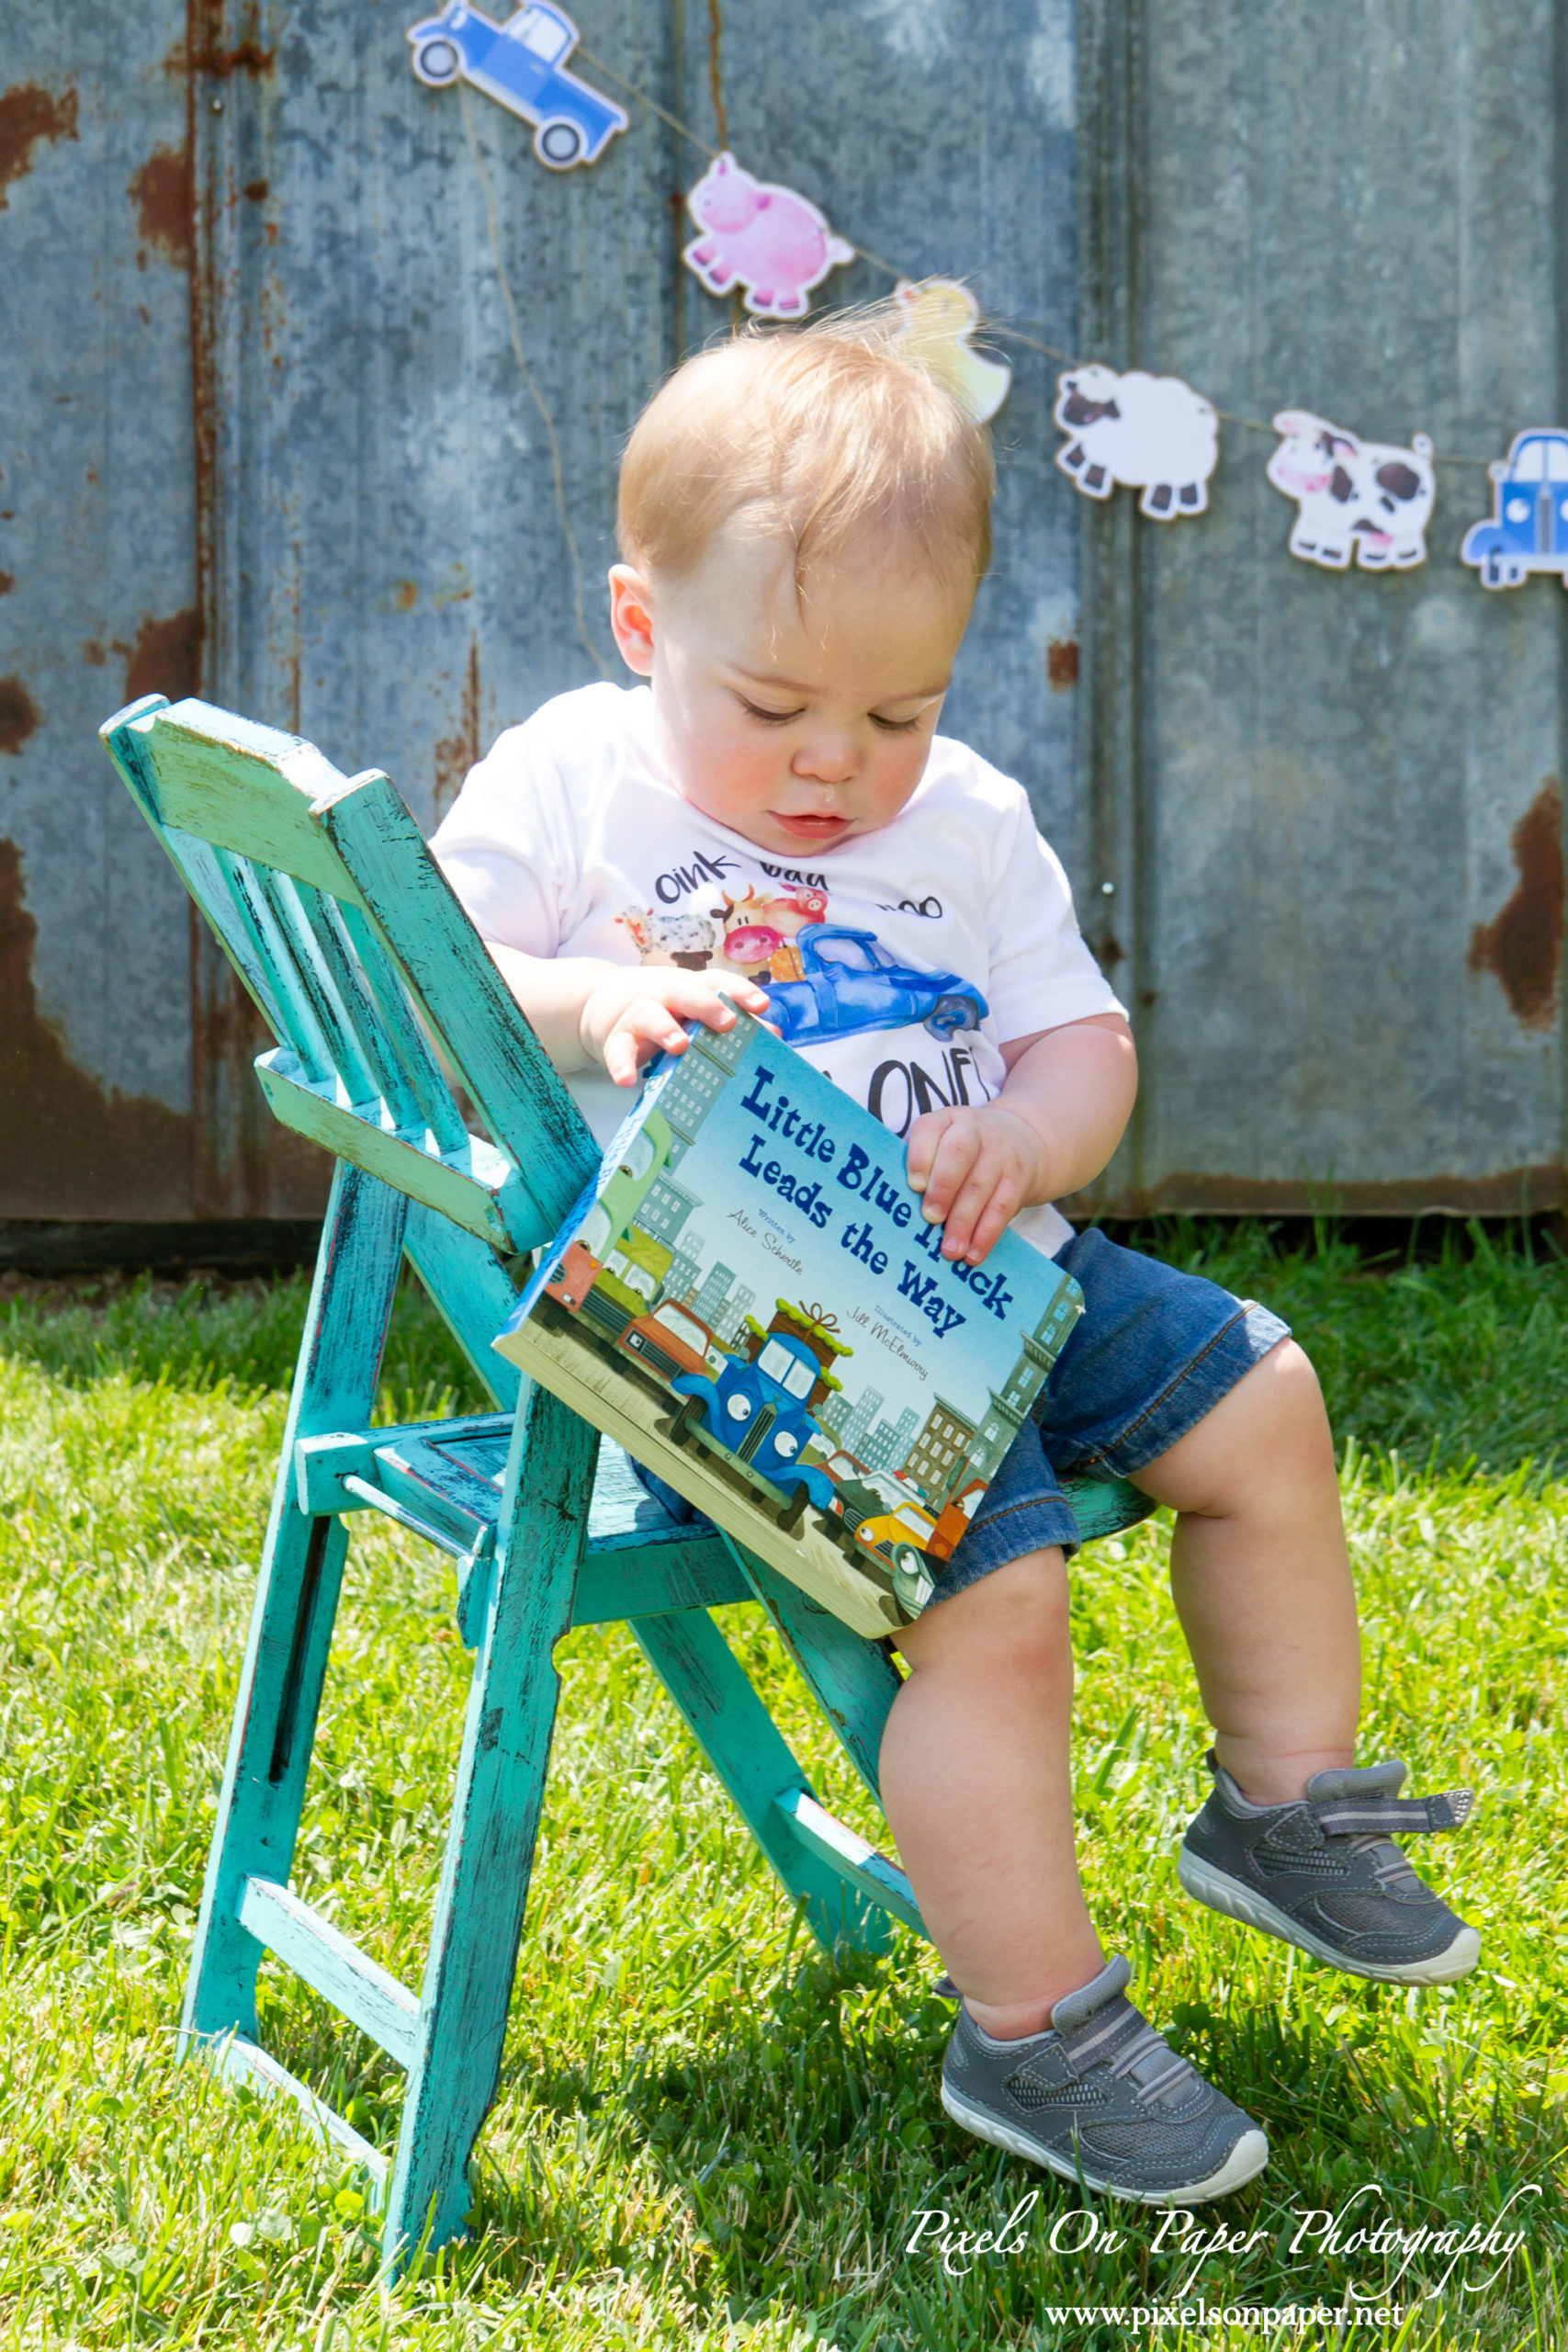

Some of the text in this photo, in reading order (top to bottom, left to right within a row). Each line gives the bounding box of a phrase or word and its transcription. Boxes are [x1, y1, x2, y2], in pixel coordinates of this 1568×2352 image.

[655, 851, 742, 904] oink
[739, 1064, 836, 1163] Little
[837, 1142, 912, 1228] Blue
[726, 1208, 758, 1238] Alice
[738, 1134, 967, 1339] Leads the Way
[846, 1306, 871, 1329] Jill
